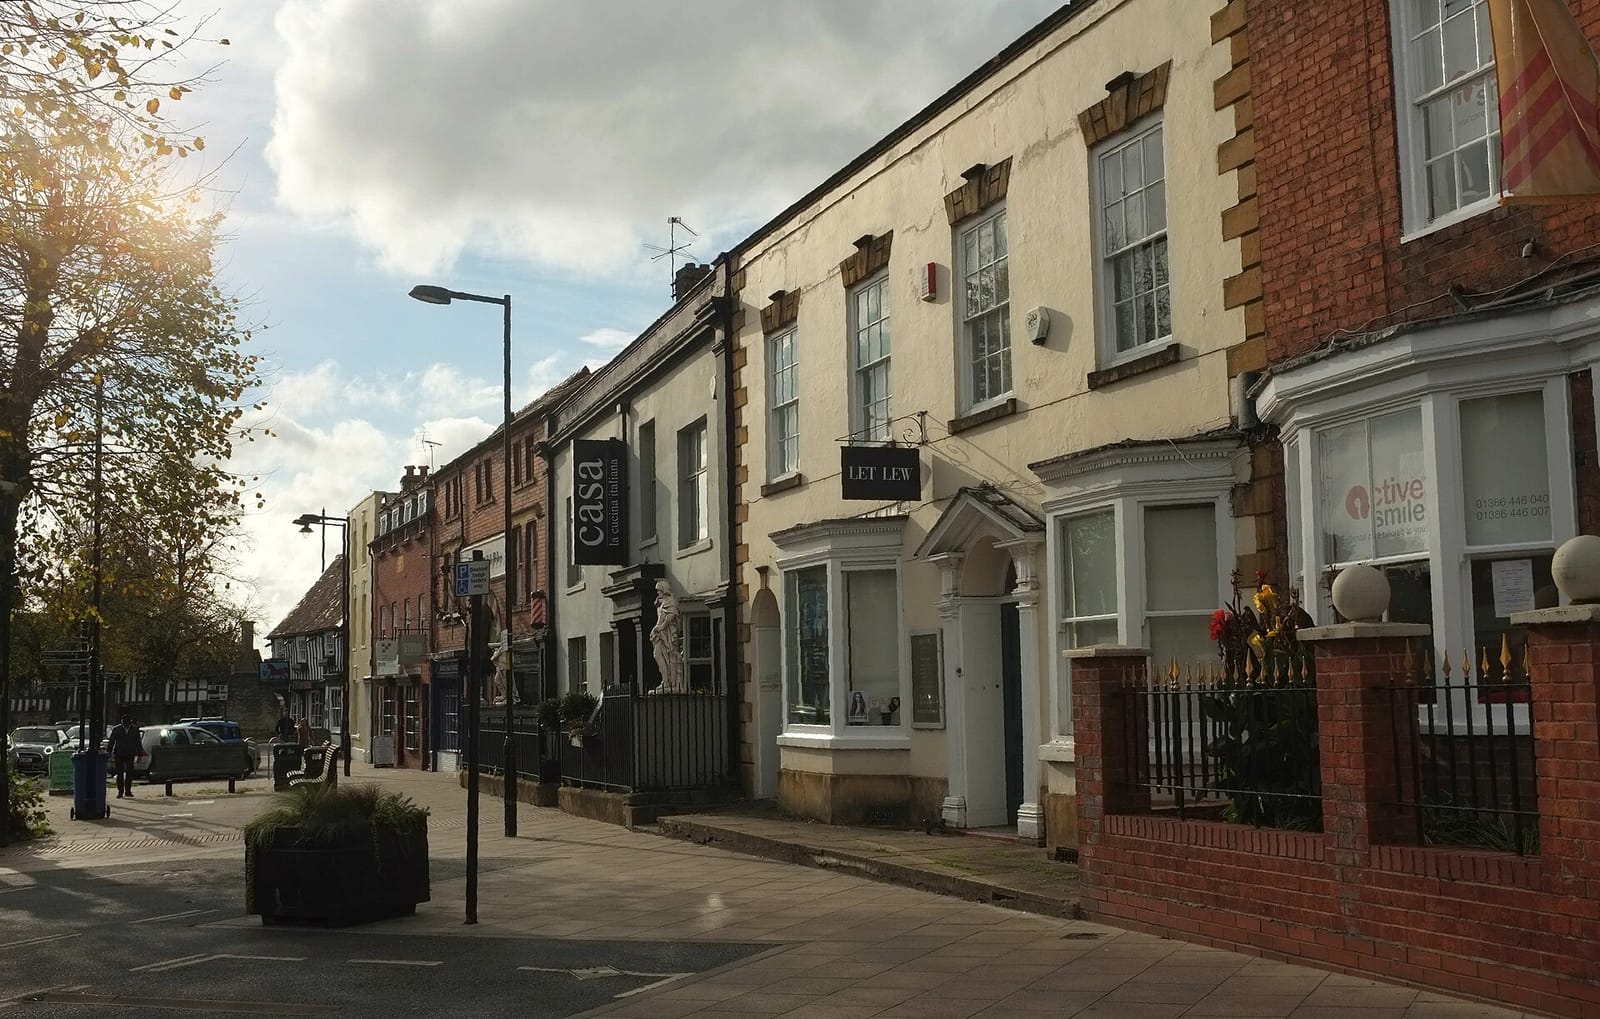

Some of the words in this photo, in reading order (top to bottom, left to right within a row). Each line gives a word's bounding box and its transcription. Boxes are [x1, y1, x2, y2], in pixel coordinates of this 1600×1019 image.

[607, 459, 618, 497] italiana
[849, 466, 877, 480] LET
[883, 466, 913, 481] LEW
[579, 458, 604, 546] casa
[1475, 497, 1506, 509] 01386
[1530, 494, 1549, 505] 040
[608, 499, 619, 534] cucina
[1376, 499, 1425, 527] smile
[1476, 509, 1507, 521] 01386
[1510, 507, 1529, 517] 446
[1531, 505, 1550, 516] 007
[609, 537, 619, 546] la
